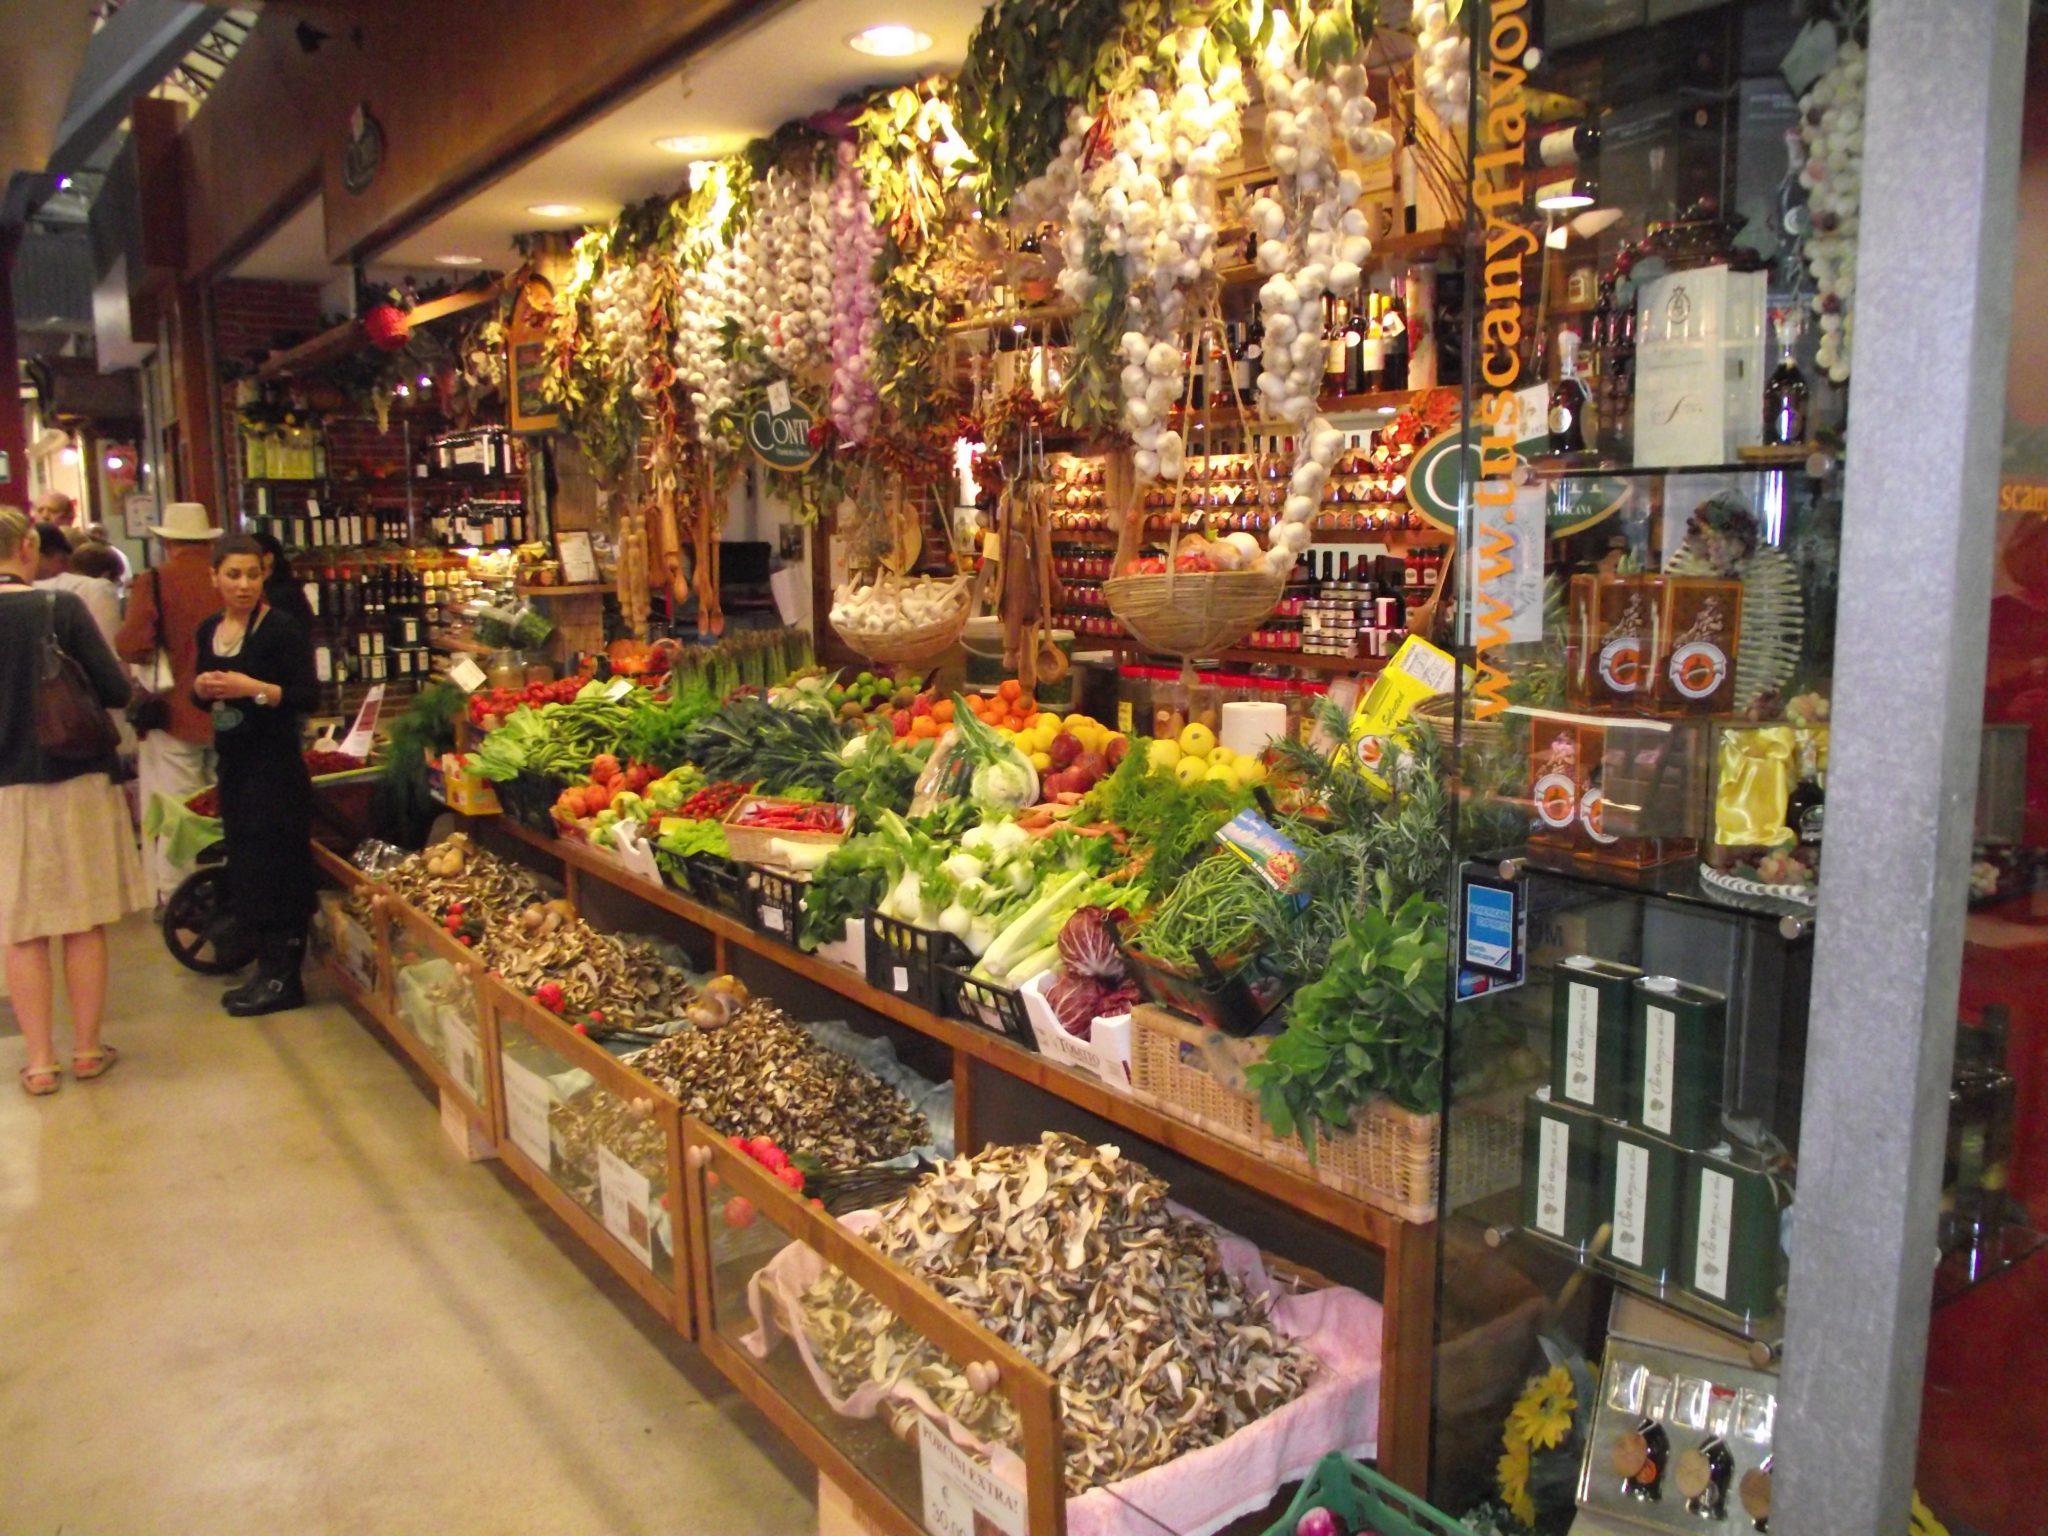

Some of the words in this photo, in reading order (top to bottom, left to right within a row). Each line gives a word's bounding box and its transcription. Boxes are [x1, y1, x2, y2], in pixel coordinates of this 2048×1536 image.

[751, 410, 809, 450] CONT
[922, 1425, 967, 1475] PORCINI
[969, 1467, 1018, 1514] EXTRA!
